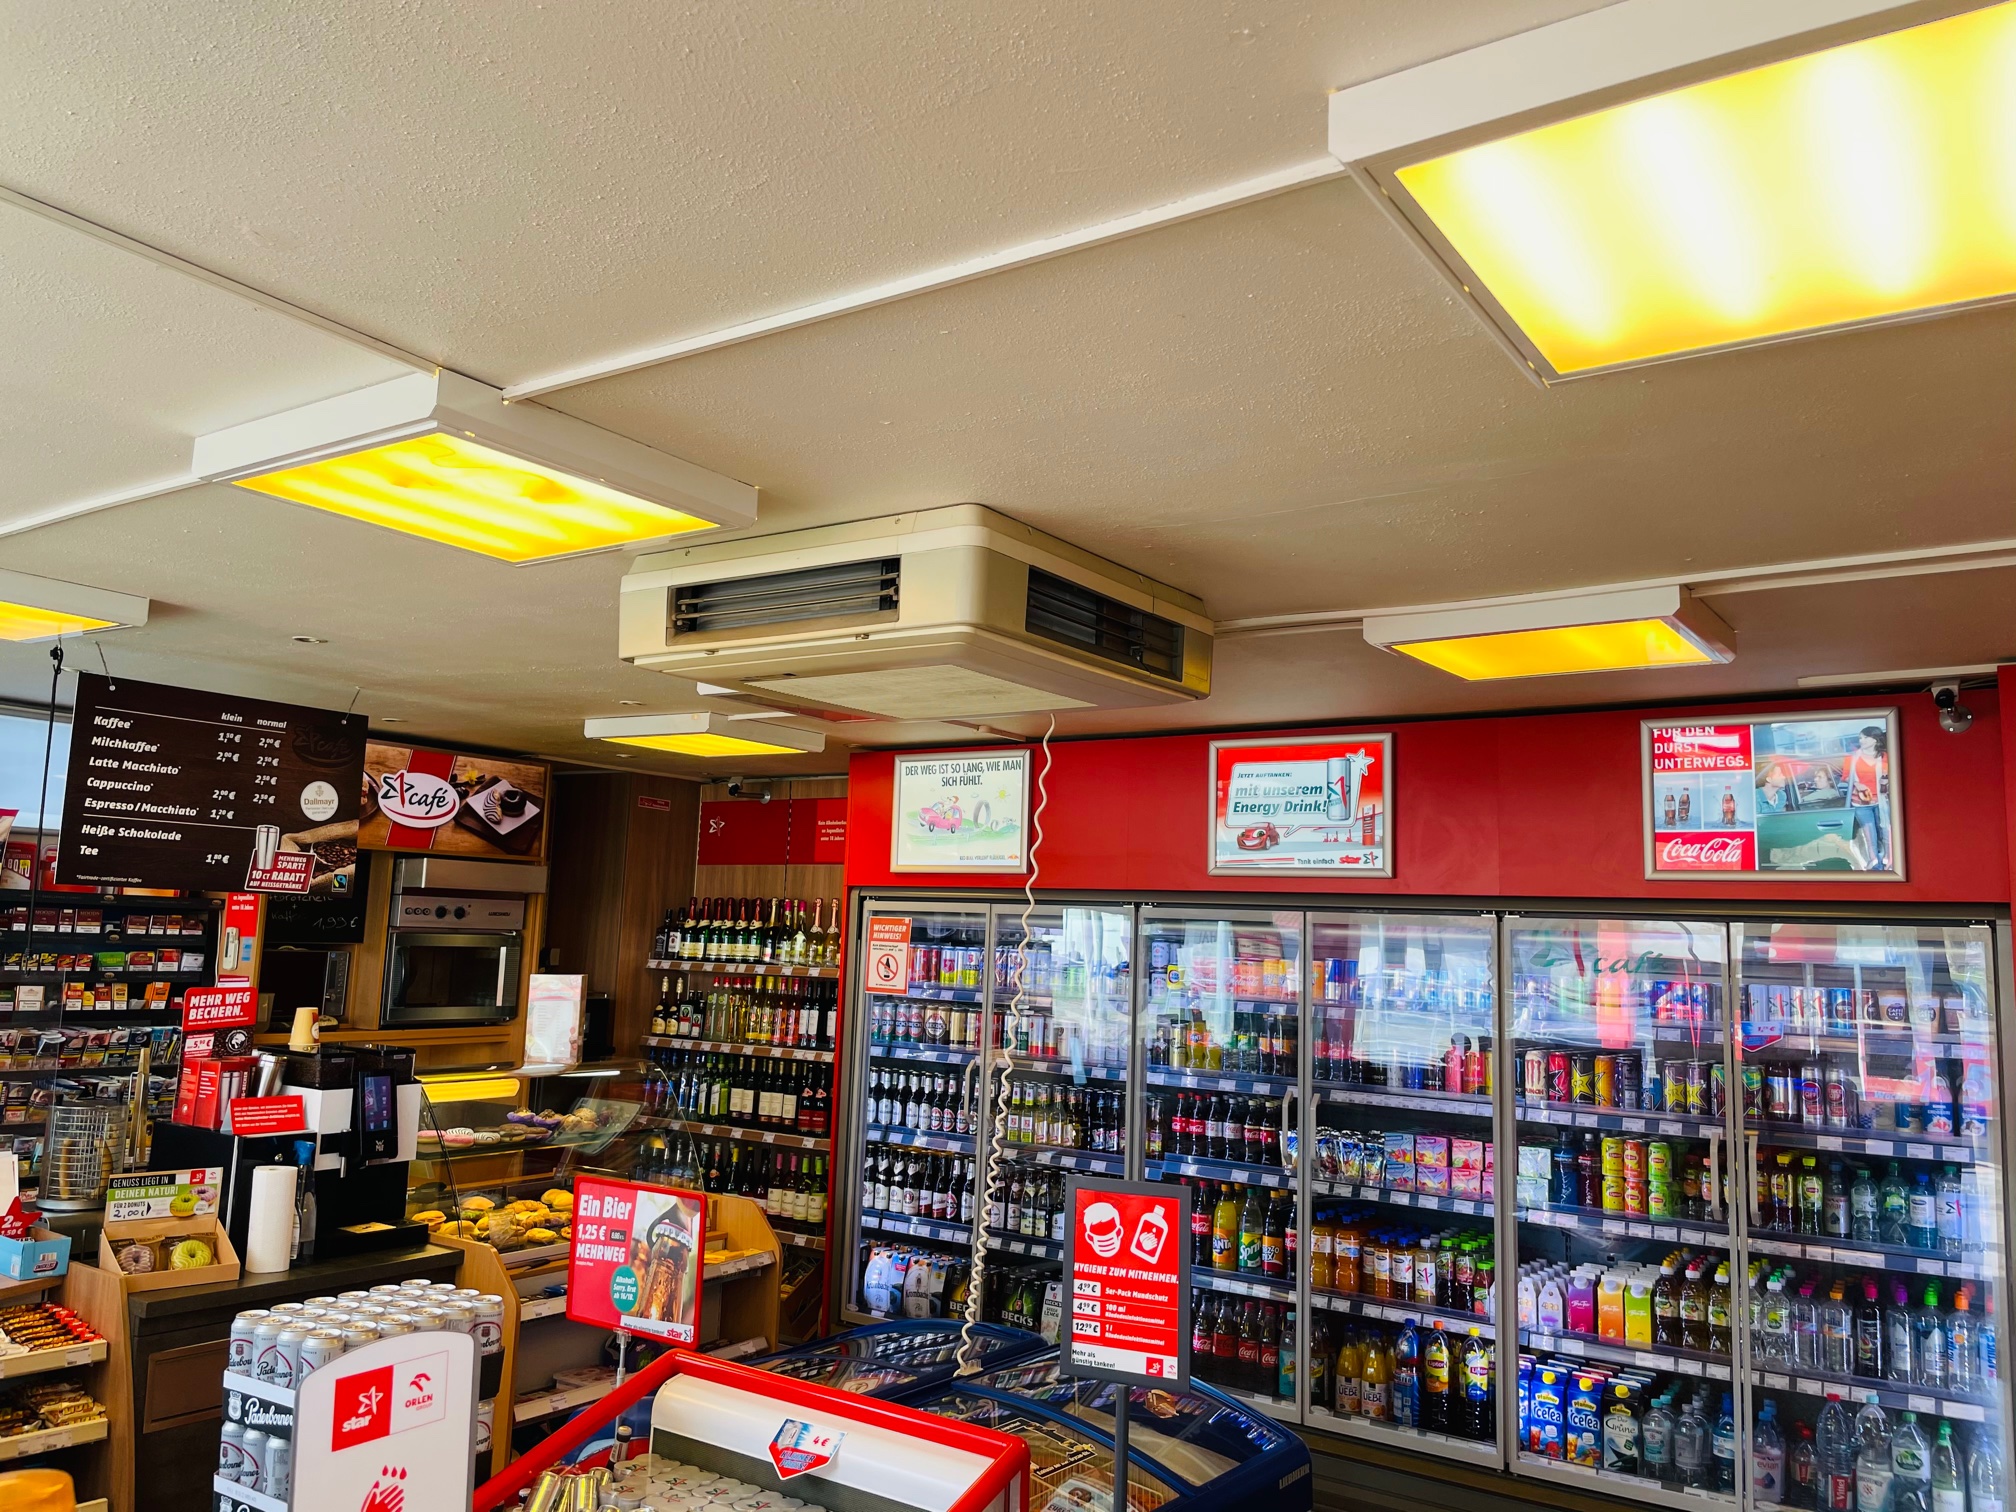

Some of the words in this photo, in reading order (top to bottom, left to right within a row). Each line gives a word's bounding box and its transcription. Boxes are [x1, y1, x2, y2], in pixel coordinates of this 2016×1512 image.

[221, 712, 243, 723] klein
[257, 719, 287, 729] normal
[1685, 726, 1715, 736] DEN
[1654, 743, 1700, 754] DURST
[89, 756, 119, 768] Latte
[905, 765, 919, 776] DER
[920, 764, 937, 775] WEG
[938, 763, 949, 774] IST
[951, 763, 960, 774] SO
[962, 762, 985, 774] LANG,
[986, 760, 1001, 772] WIE
[1002, 760, 1022, 771] MAN
[1655, 756, 1749, 769] UNTERWEGS.
[941, 776, 958, 787] SICH
[959, 773, 983, 786] FÜHLT.
[1235, 784, 1259, 797] mit
[1263, 784, 1323, 796] unserem
[304, 798, 335, 806] Dallmayr
[408, 788, 449, 815] café
[1233, 801, 1281, 816] Energy
[1284, 800, 1328, 813] Drink!
[81, 824, 115, 837] Heiße
[118, 827, 182, 841] Schokolade
[80, 845, 99, 856] Tee
[1662, 837, 1746, 863] Coca-Cola
[278, 855, 307, 863] MEHRWEG
[1339, 855, 1362, 865] star
[277, 862, 306, 871] SPART!
[251, 870, 262, 879] 10
[271, 871, 306, 882] RABATT
[873, 924, 907, 932] WICHTIGER
[873, 932, 901, 940] HINWEIS!
[190, 994, 223, 1007] MEHR
[225, 992, 251, 1004] WEG
[188, 1004, 244, 1020] BECHERN.
[113, 1177, 140, 1188] GENUSS
[141, 1176, 159, 1186] LIEGT
[161, 1176, 169, 1185] IN
[115, 1187, 145, 1199] DEINER
[148, 1186, 179, 1197] NATUR!
[114, 1201, 123, 1209] FÜR
[578, 1194, 601, 1217] Ein
[602, 1196, 633, 1220] Bier
[113, 1209, 140, 1219] 2,00
[1, 1215, 14, 1229] 2
[577, 1223, 598, 1240] 1,25
[599, 1225, 607, 1240] €
[576, 1243, 626, 1263] MEHRWEG
[1074, 1262, 1107, 1276] HYGIENE
[1109, 1267, 1127, 1278] ZUM
[1128, 1269, 1179, 1284] MITNEHMEN.
[1077, 1283, 1091, 1293] 4,99
[1091, 1285, 1097, 1293] €
[1105, 1287, 1131, 1298] 5er-Pack
[1132, 1291, 1169, 1302] Mundschutz
[1077, 1302, 1090, 1312] 4,99
[1091, 1304, 1097, 1312] €
[1105, 1304, 1116, 1312] 100
[1002, 1310, 1034, 1326] BECK'S
[666, 1328, 682, 1339] star
[1075, 1322, 1092, 1333] 12,99
[1093, 1325, 1099, 1333] €
[1071, 1349, 1086, 1357] Mehr
[1087, 1350, 1096, 1358] als
[1071, 1358, 1093, 1366] günstig
[1093, 1360, 1116, 1369] tanken!
[405, 1394, 433, 1408] ORLEN
[244, 1398, 293, 1426] Paderborner
[342, 1415, 372, 1432] star
[1606, 1417, 1636, 1434] Grüne
[813, 1436, 820, 1445] 4
[821, 1438, 830, 1447] €
[1757, 1461, 1779, 1469] evian
[1836, 1479, 1846, 1501] Vittel
